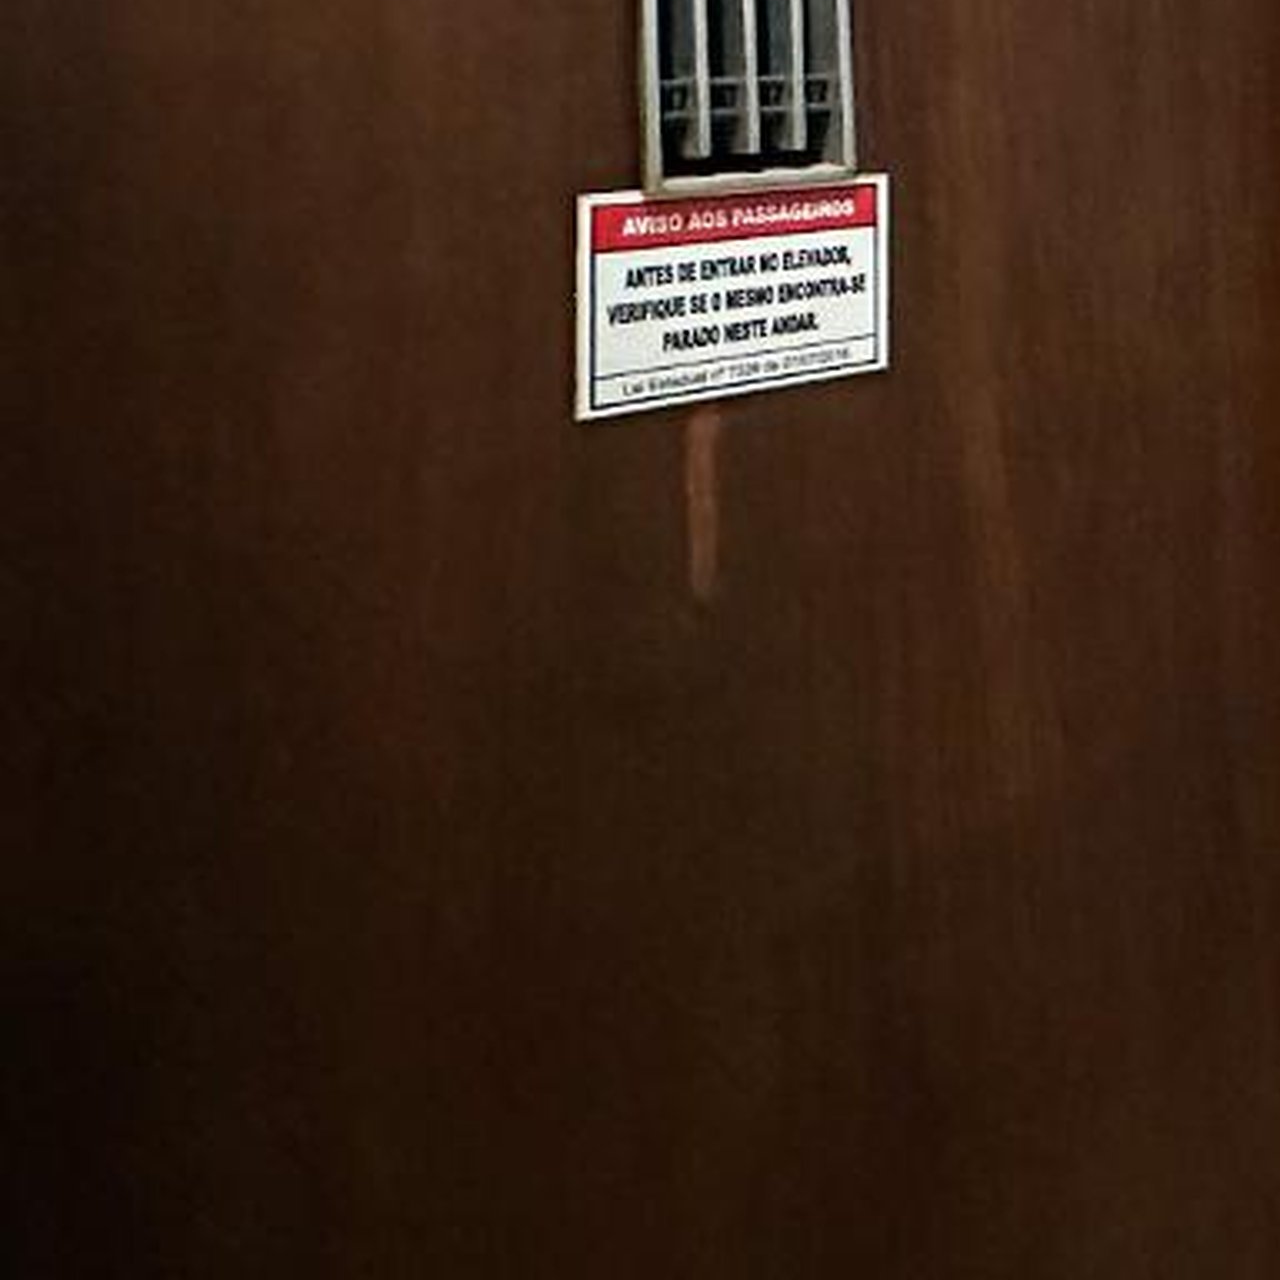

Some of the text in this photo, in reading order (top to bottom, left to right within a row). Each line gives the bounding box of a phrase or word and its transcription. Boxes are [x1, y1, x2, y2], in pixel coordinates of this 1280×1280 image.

[622, 198, 855, 237] AVISO AOS PASSAGEIROS
[625, 245, 851, 289] ANTES DE ENTRAR NO ELEVADOR,
[606, 273, 866, 326] VERIFIQUE SE O MESMO ENCONTRA-SE
[662, 324, 720, 352] PARADO
[723, 318, 767, 343] NESTE
